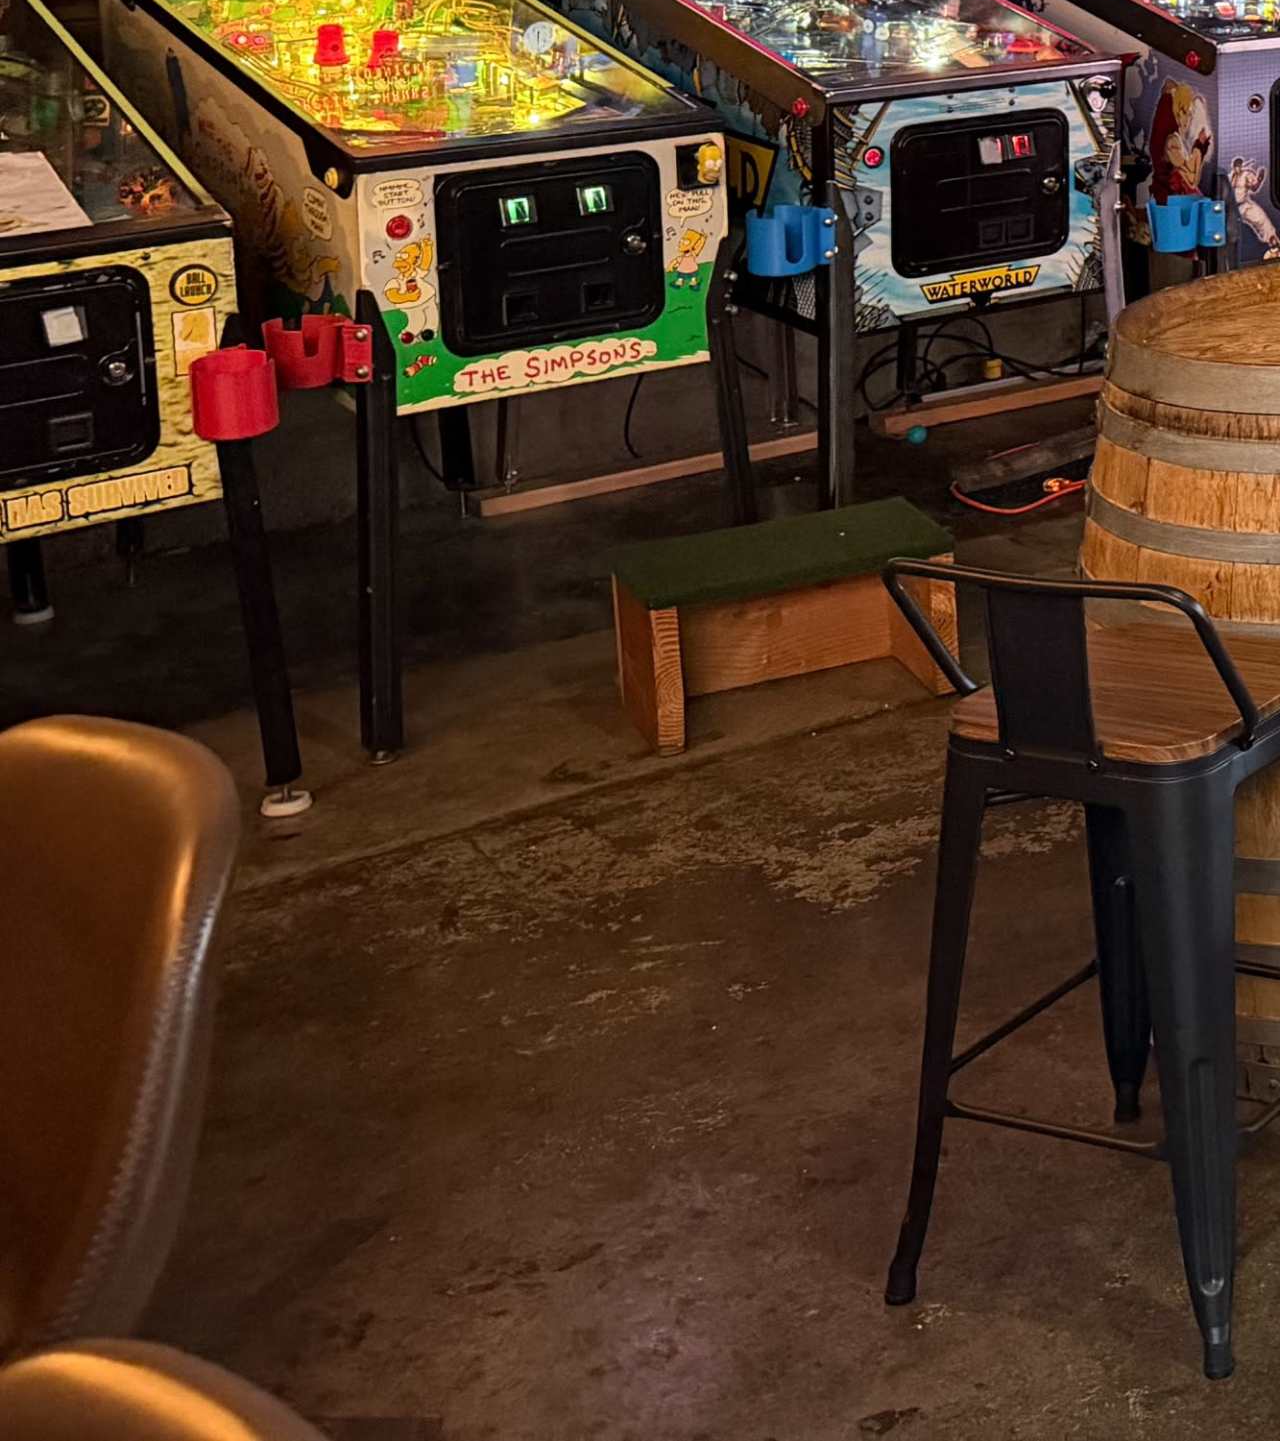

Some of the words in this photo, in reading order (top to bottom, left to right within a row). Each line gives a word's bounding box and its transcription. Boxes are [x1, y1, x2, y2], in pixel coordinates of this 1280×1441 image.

[384, 189, 408, 199] START
[186, 271, 206, 284] BALL
[925, 266, 1034, 299] WATERWORLD
[179, 280, 212, 299] LAUNCH
[460, 365, 512, 387] THE
[524, 341, 642, 379] SIMPSONS
